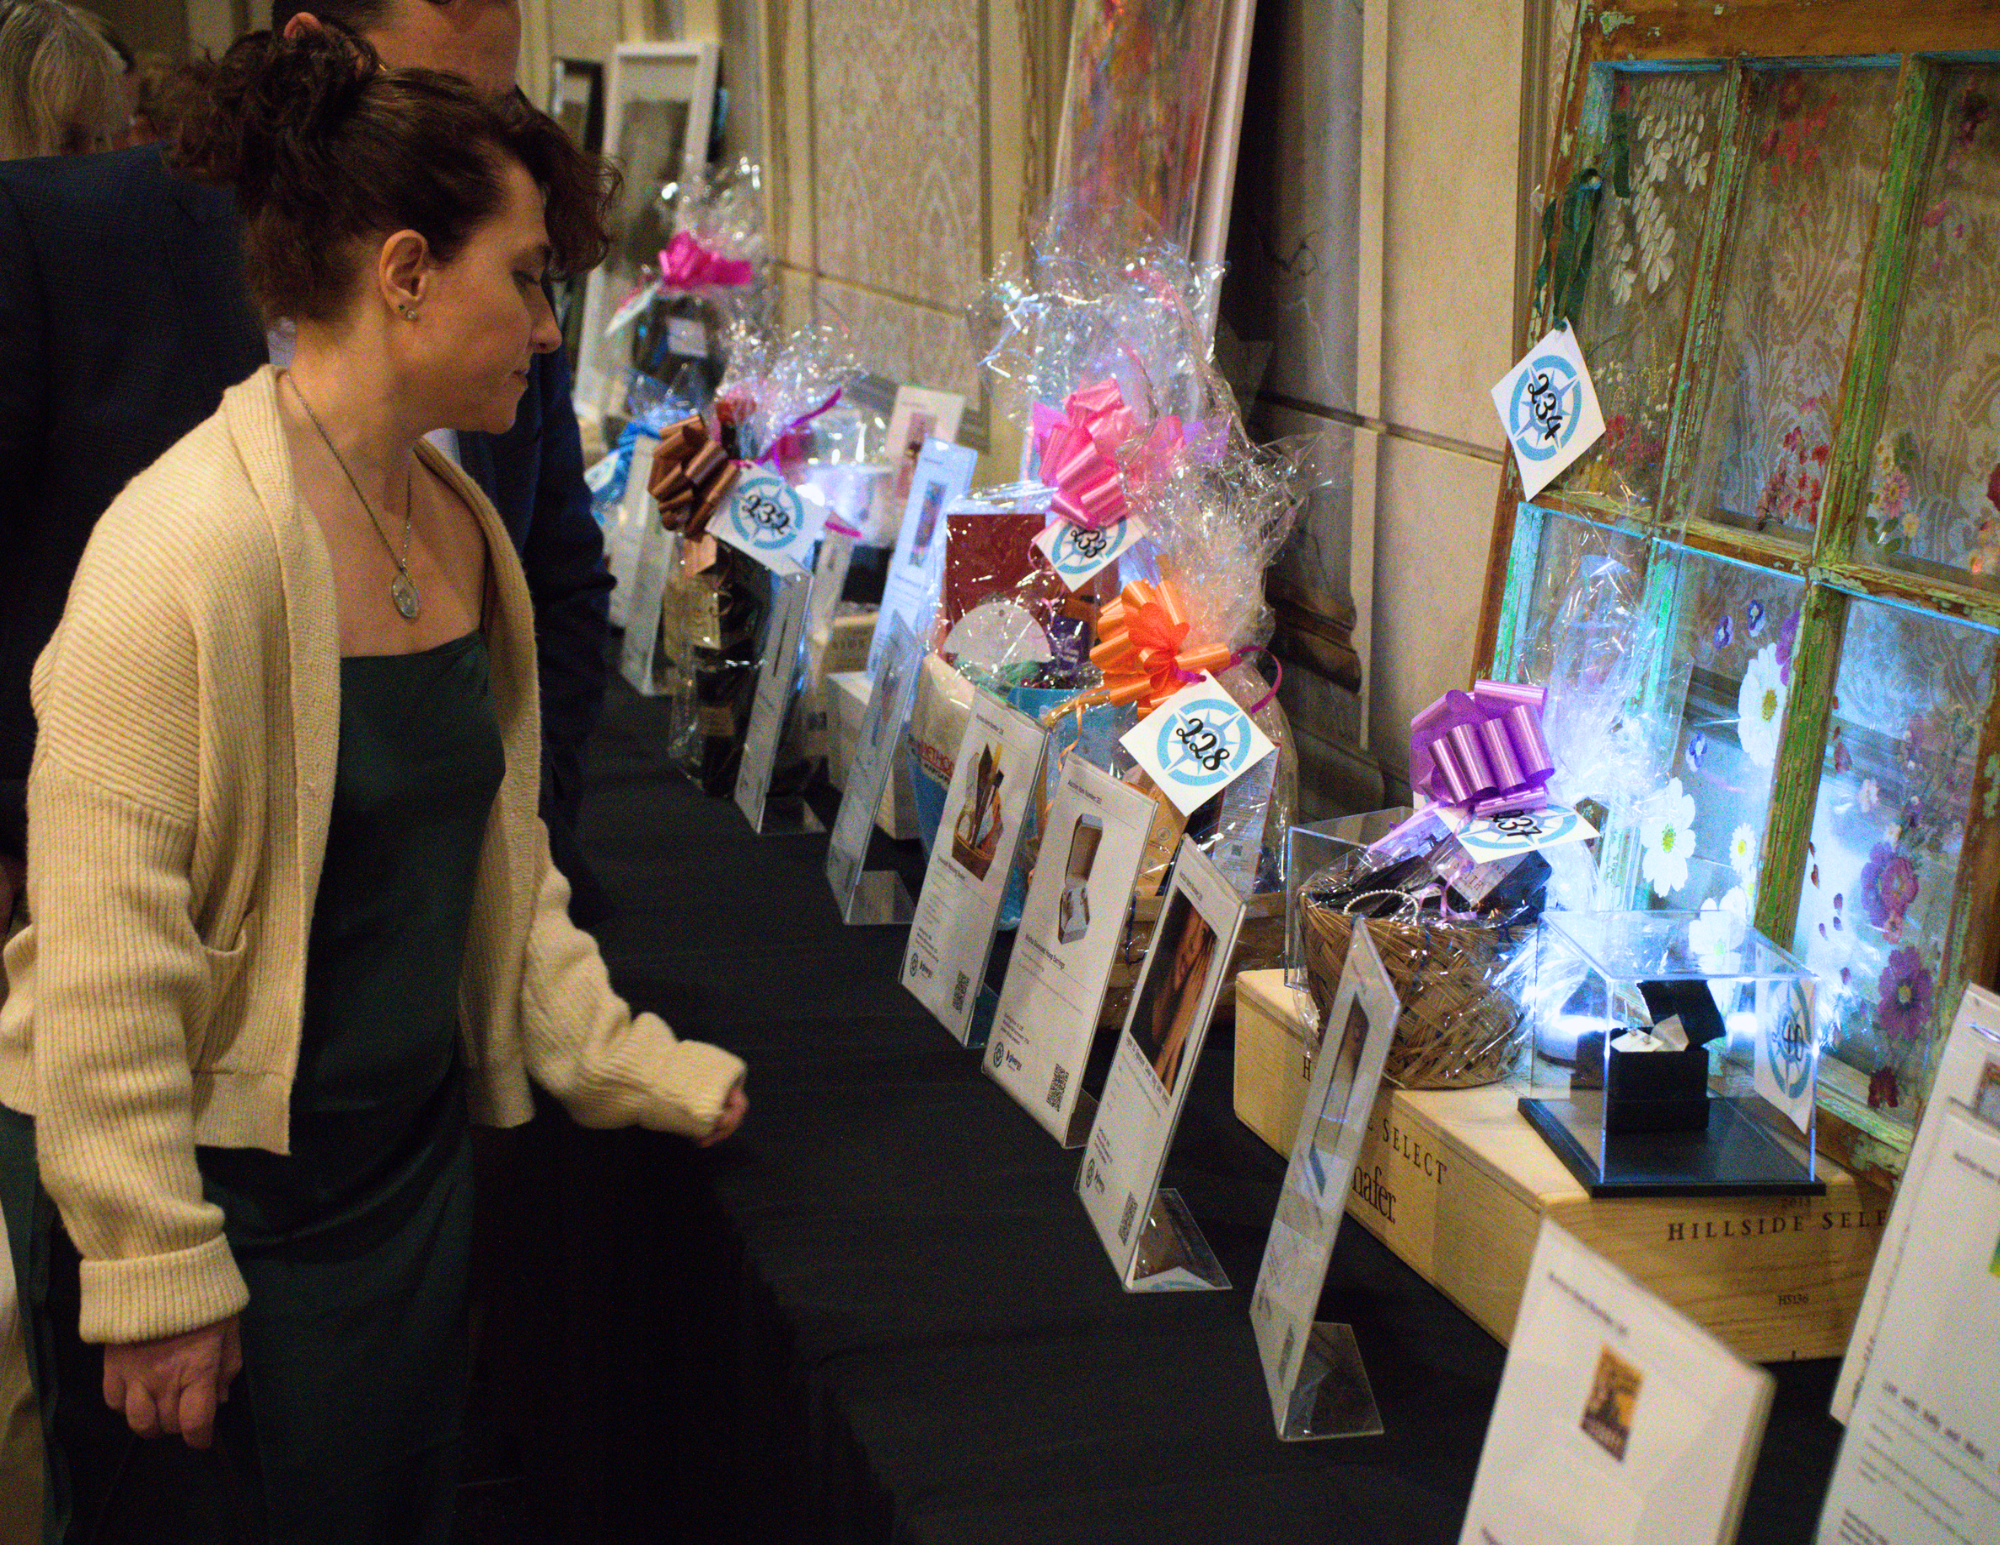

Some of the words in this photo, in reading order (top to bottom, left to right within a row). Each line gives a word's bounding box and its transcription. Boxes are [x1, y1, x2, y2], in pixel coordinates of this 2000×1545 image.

[1527, 373, 1563, 441] 234
[741, 494, 790, 535] 232
[1175, 717, 1230, 771] 228
[1382, 1117, 1448, 1186] SELECT
[1667, 1215, 1804, 1242] HILLSIDE
[1821, 1209, 1888, 1231] SELE
